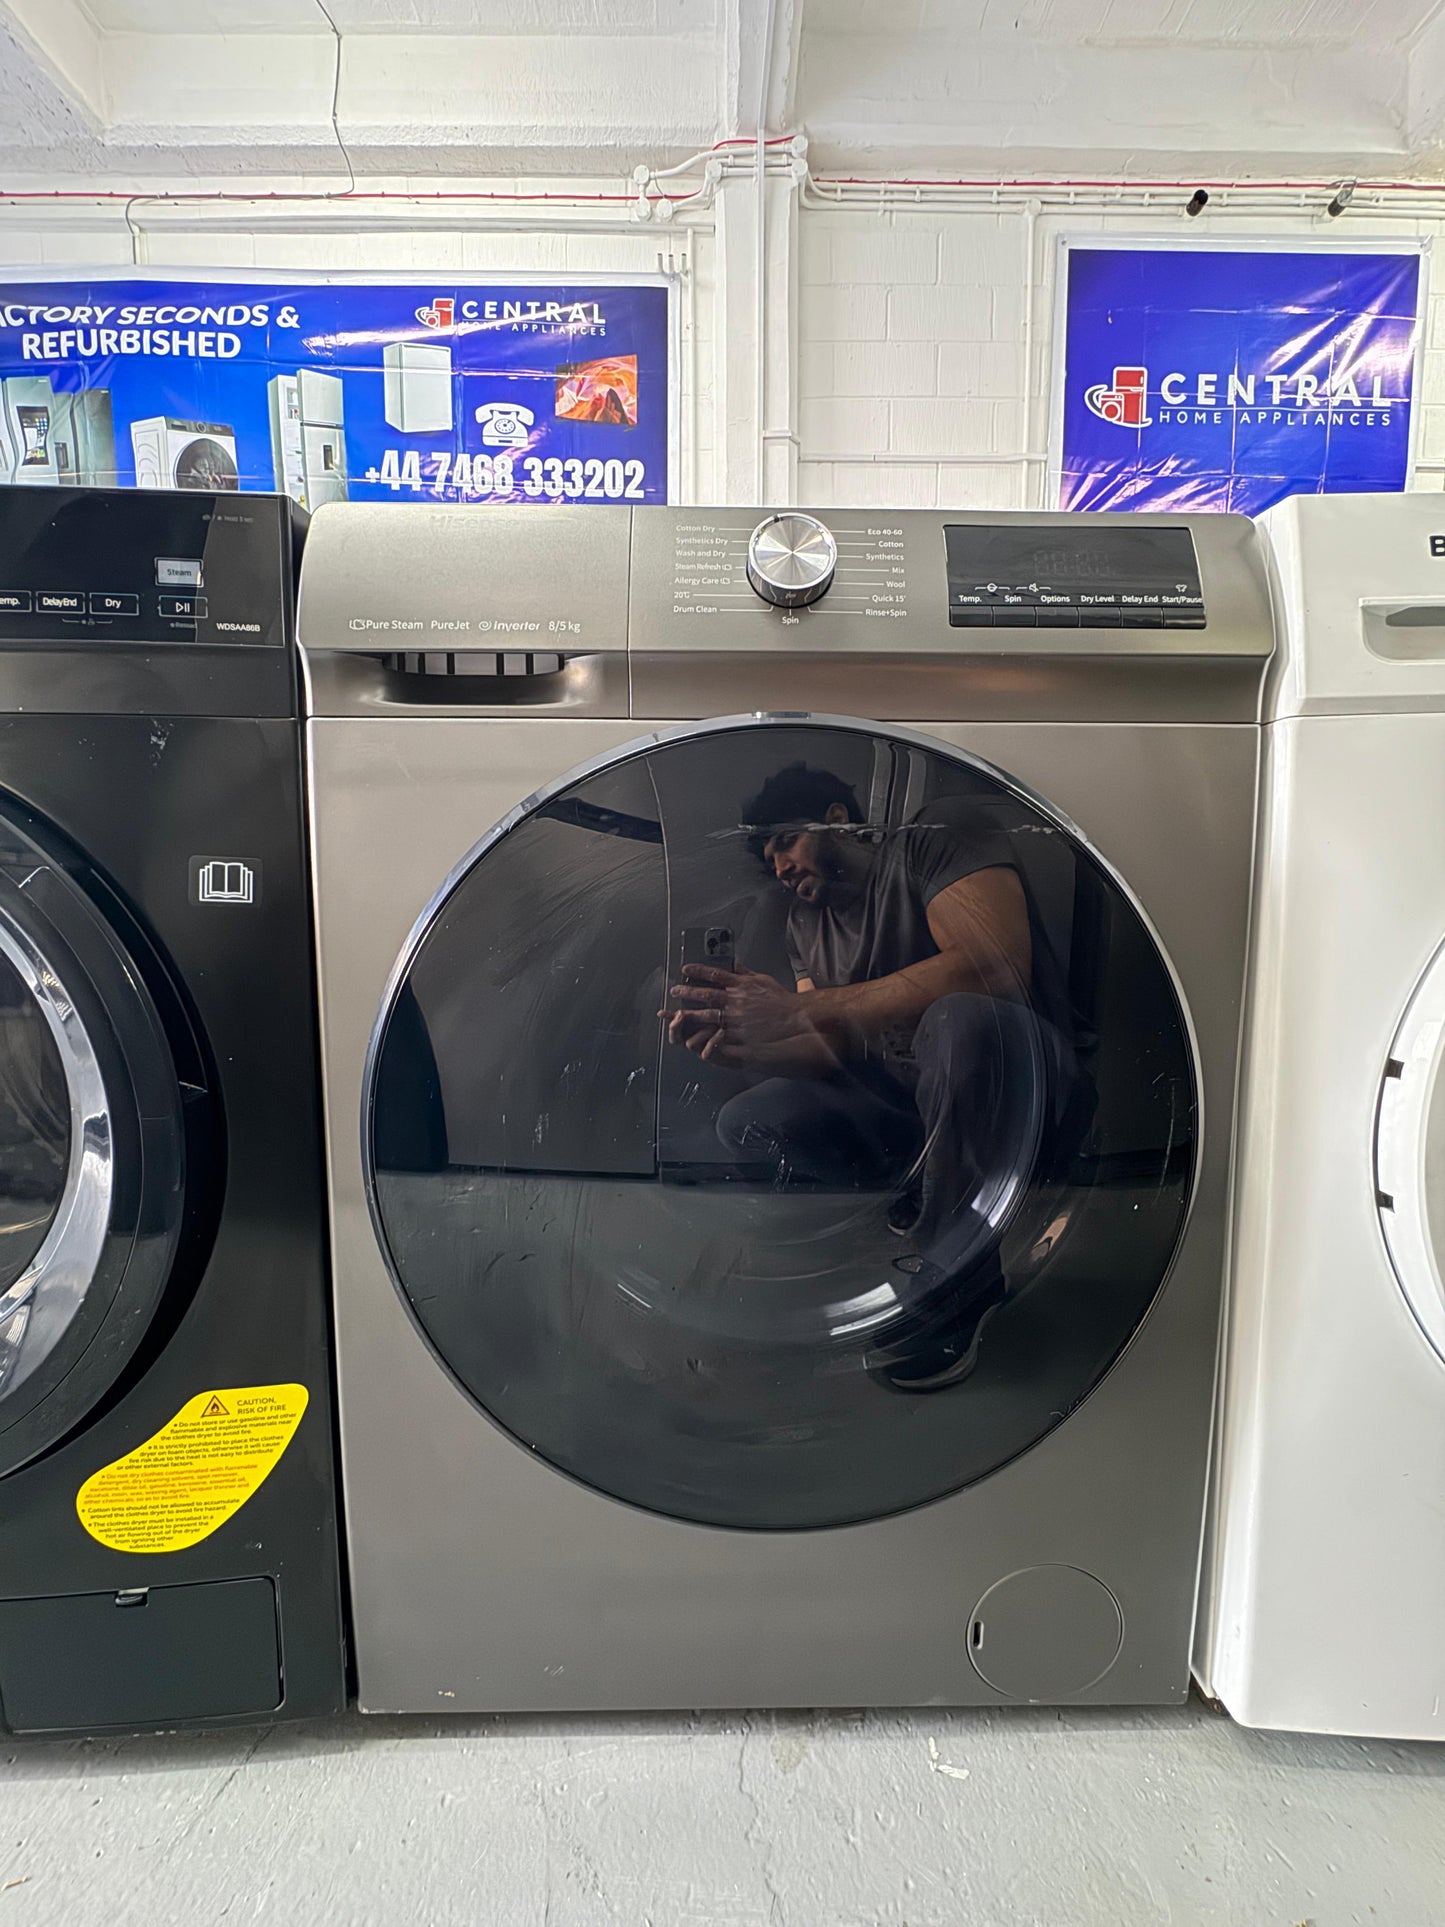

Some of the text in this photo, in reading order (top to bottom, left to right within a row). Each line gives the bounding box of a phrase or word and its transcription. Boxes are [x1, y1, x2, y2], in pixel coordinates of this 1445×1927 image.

[117, 304, 269, 326] SECONDS
[276, 305, 300, 328] &
[462, 300, 606, 324] CENTRAL
[512, 322, 606, 337] APPLIANCES
[22, 328, 241, 360] REFURBISHED
[1161, 373, 1391, 407] CENTRAL
[1159, 410, 1391, 426] HOME APPLIANCES
[365, 449, 645, 499] +44 7468 333202
[702, 525, 715, 533] Dry
[675, 537, 714, 545] Synthetics
[713, 550, 726, 558] Dry
[865, 553, 904, 561] Synthetics
[166, 568, 192, 577] Steam
[674, 577, 700, 585] Allergy
[105, 598, 121, 609] Dry
[872, 595, 894, 603] Quick
[958, 595, 982, 604] Temp.
[1004, 595, 1022, 604] Spin
[1040, 595, 1071, 604] Options
[1080, 595, 1115, 604] Dry Level
[1121, 595, 1159, 604] Delay End
[1162, 596, 1203, 604] Start/Pause
[695, 605, 717, 613] Clean
[865, 609, 907, 617] Rinse+Spin
[366, 619, 424, 630] Pure Steam
[430, 619, 470, 630] PureJet
[782, 616, 799, 625] Spin
[493, 620, 540, 632] Inverter
[237, 1407, 255, 1415] RISK
[269, 1404, 286, 1412] FIRE
[239, 1415, 265, 1423] gasoline
[170, 1426, 204, 1434] flammable
[218, 1422, 247, 1431] explosive
[196, 1431, 213, 1439] dryer
[188, 1440, 221, 1448] prohibited
[130, 1518, 147, 1526] dryer
